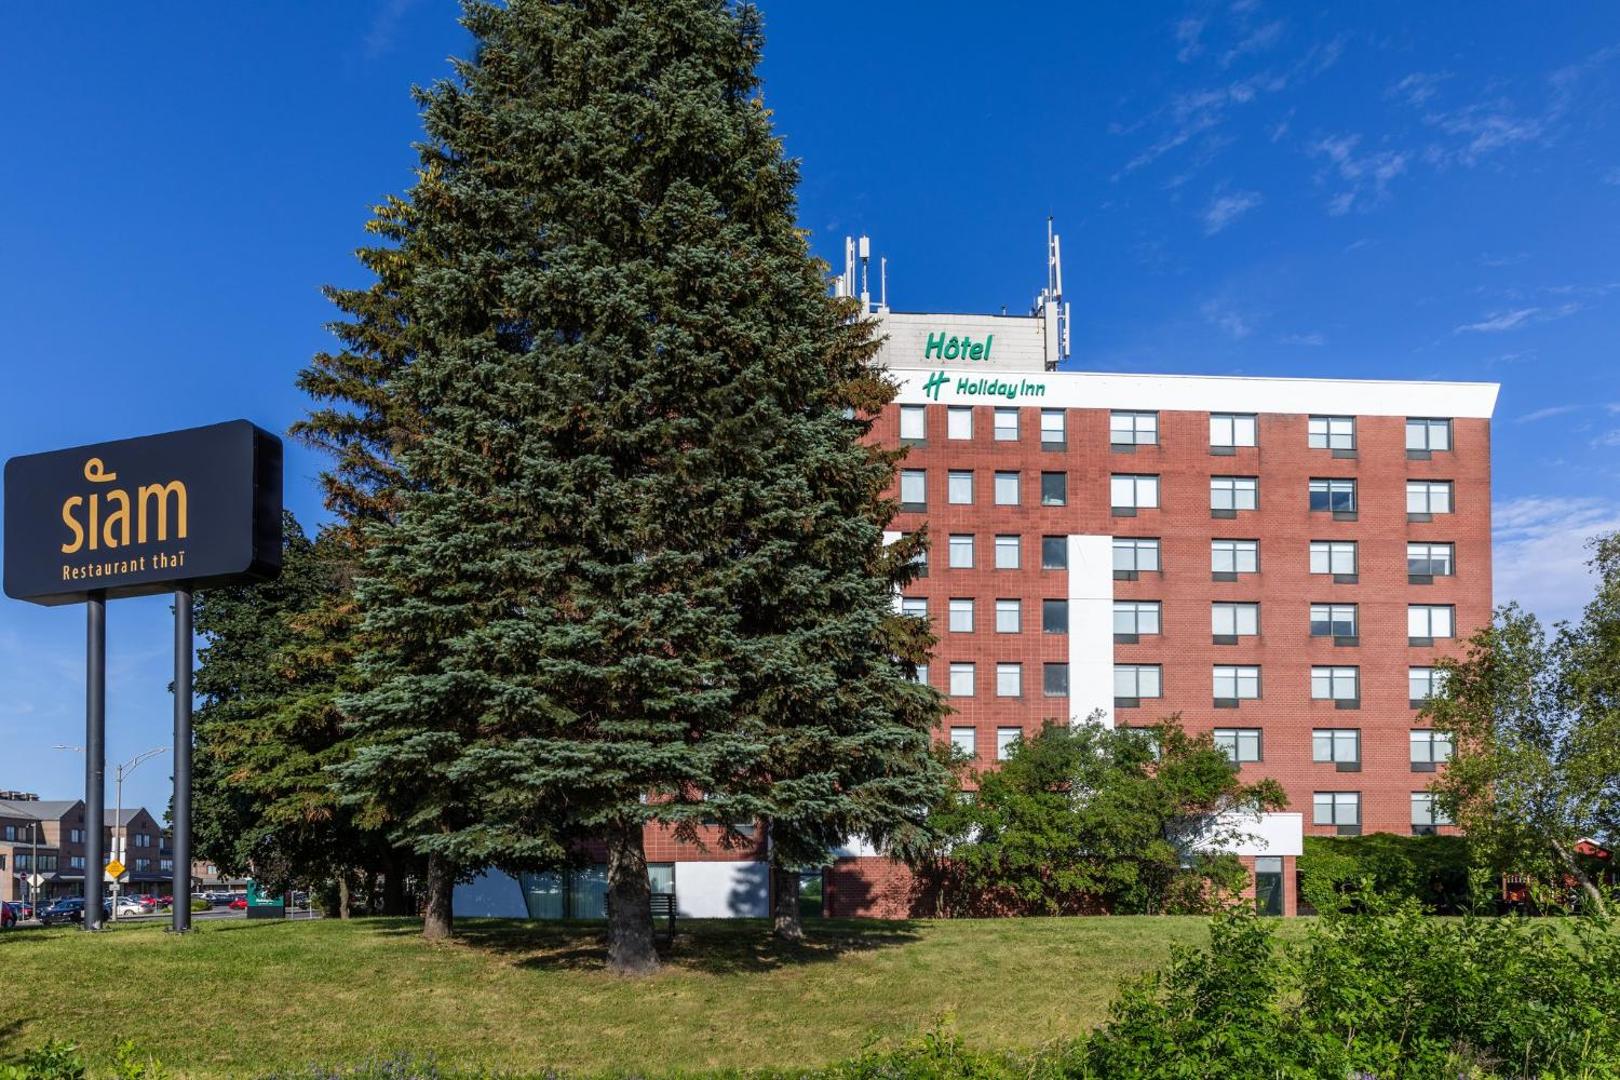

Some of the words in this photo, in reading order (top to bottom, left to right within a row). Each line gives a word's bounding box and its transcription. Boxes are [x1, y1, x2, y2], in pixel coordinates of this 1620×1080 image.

[925, 332, 993, 361] Hôtel
[956, 377, 1018, 399] Holiday
[1020, 378, 1046, 396] Inn
[63, 556, 145, 581] Restaurant
[152, 551, 185, 569] thaï
